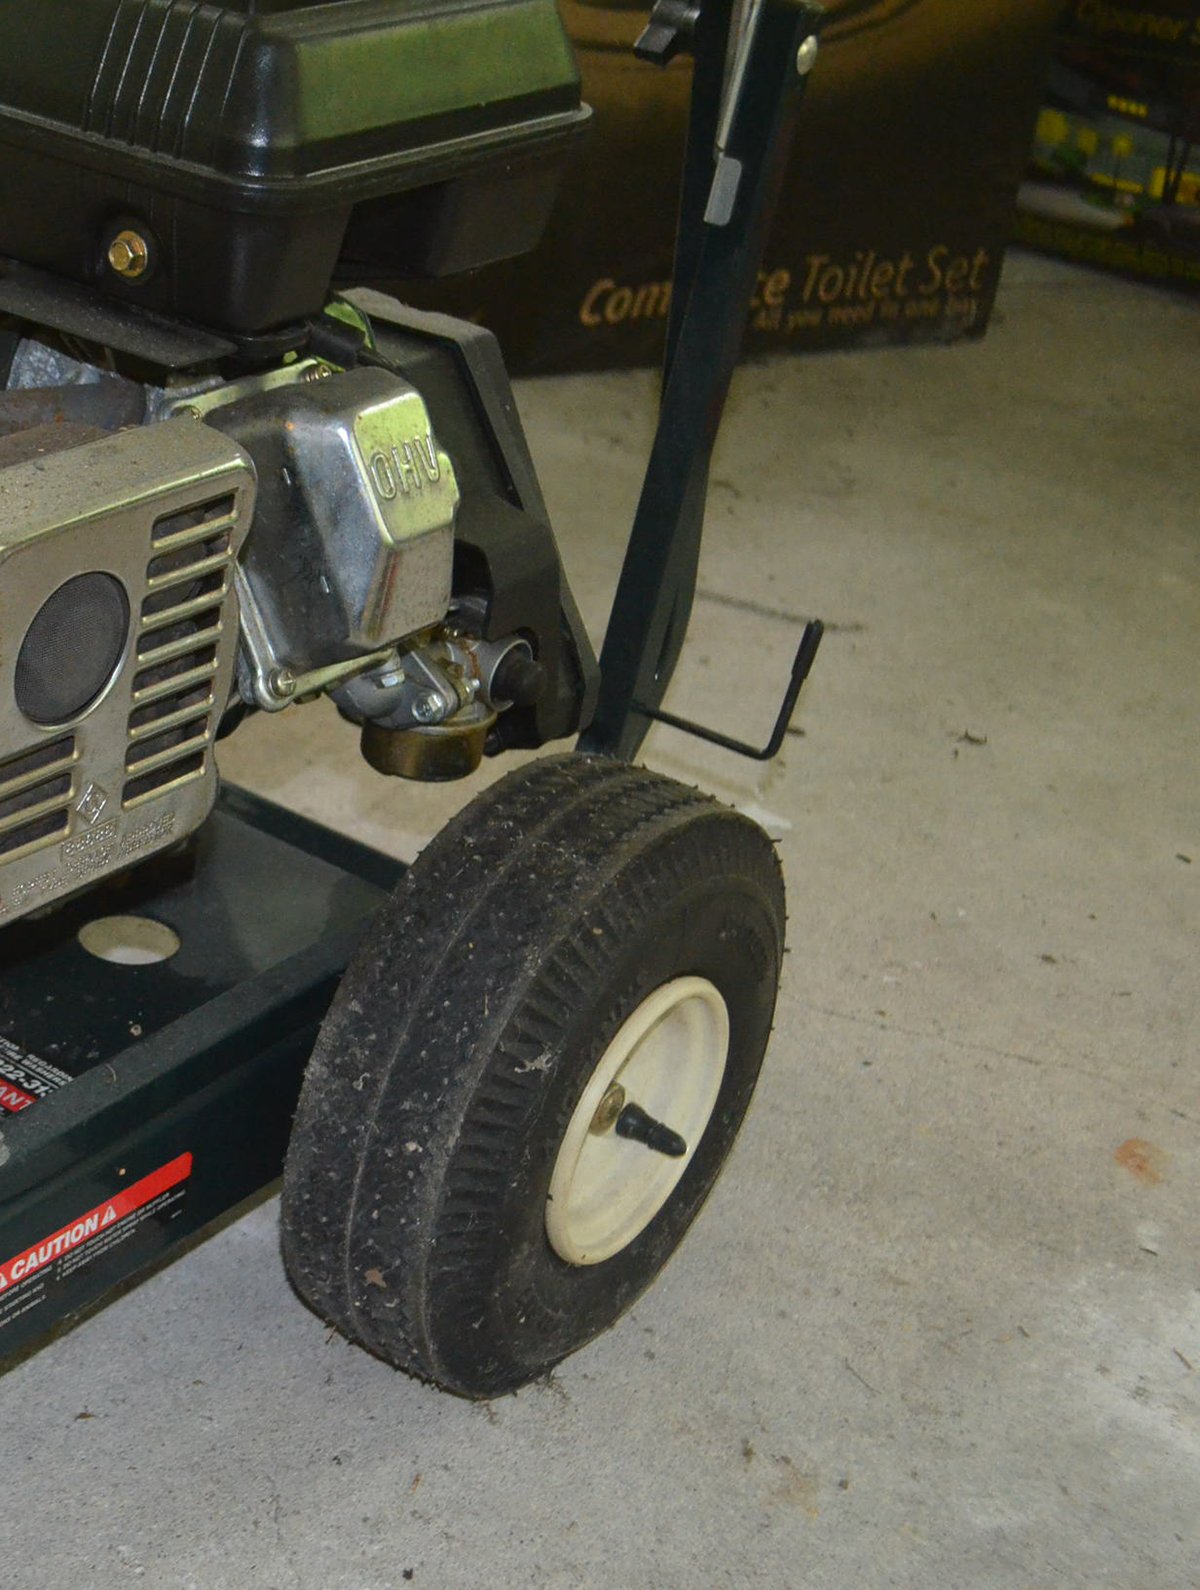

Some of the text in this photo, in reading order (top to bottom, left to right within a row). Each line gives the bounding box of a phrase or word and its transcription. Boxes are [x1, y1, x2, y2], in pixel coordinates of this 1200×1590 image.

[801, 250, 914, 303] Toilet
[919, 244, 990, 295] Set
[370, 434, 440, 500] OHV
[10, 1214, 99, 1282] CAUTION
